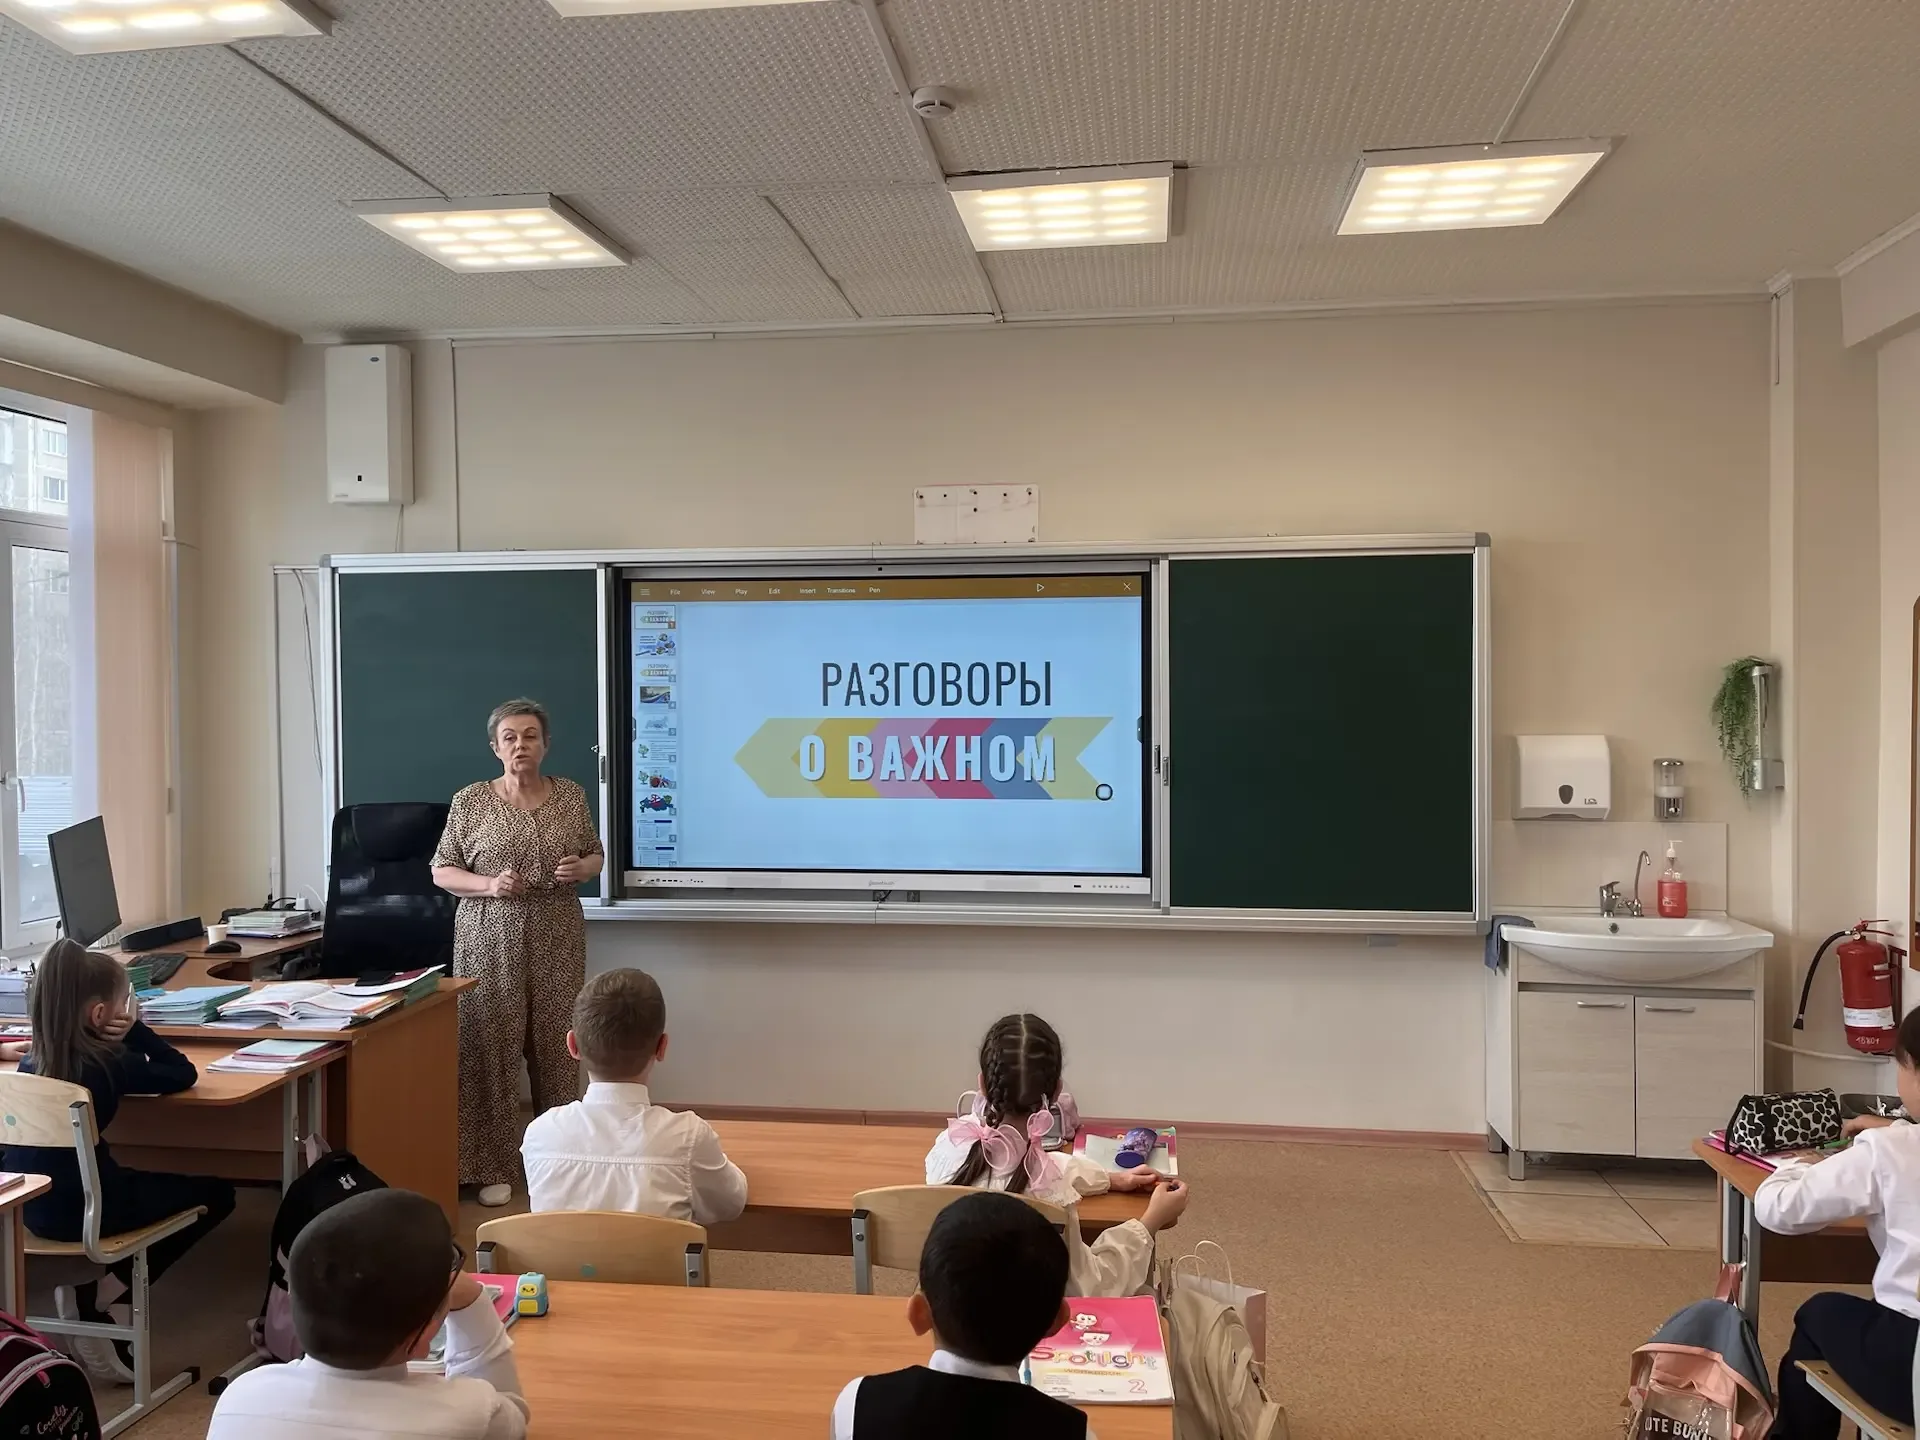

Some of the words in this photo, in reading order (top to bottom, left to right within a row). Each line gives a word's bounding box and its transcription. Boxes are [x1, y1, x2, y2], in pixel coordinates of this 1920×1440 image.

[670, 588, 681, 596] File
[701, 588, 717, 596] View
[735, 587, 748, 598] Play
[768, 587, 781, 595] Edit
[827, 586, 856, 594] Transitions
[821, 661, 1052, 707] РАЗГОВОРЫ
[799, 734, 827, 782] О
[848, 734, 1056, 783] ВАЖНОМ
[1030, 1346, 1158, 1371] Spotlight
[1127, 1378, 1148, 1395] 2
